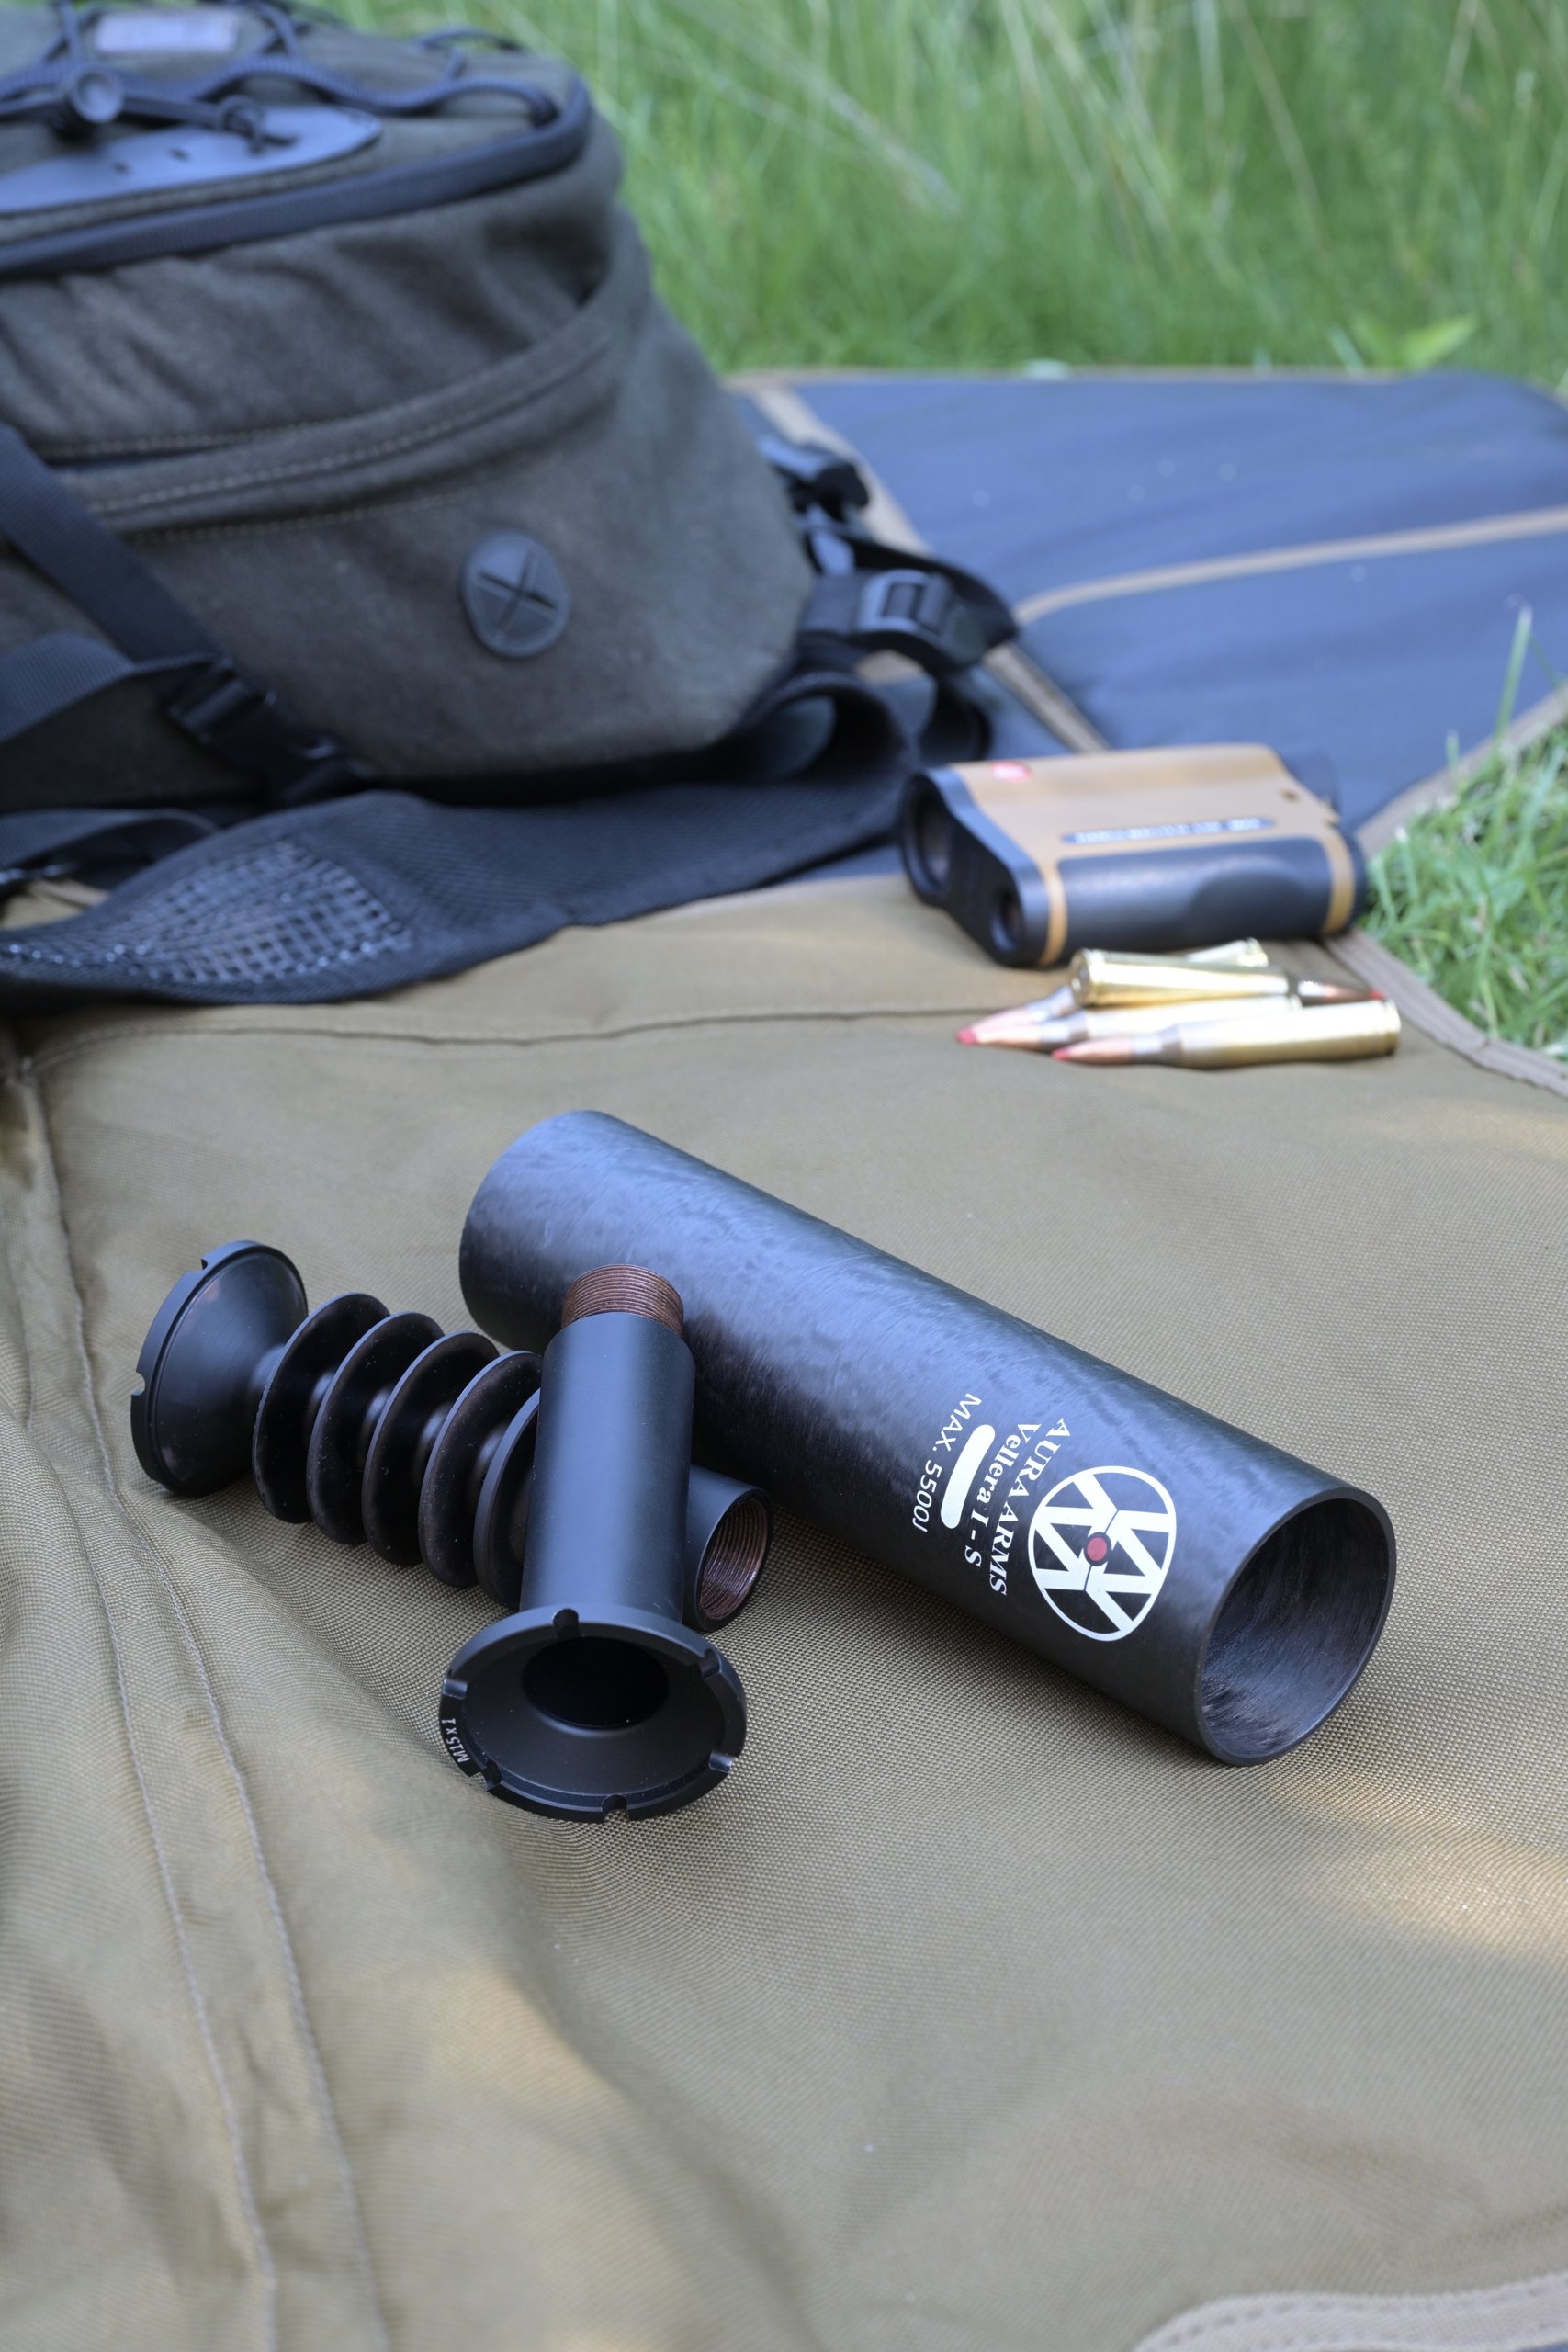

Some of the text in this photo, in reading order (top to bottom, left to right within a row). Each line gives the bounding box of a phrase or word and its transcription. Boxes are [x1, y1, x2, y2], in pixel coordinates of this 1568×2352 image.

[912, 1392, 983, 1532] MAX. 5500J
[976, 1423, 1043, 1504] Vellera
[989, 1418, 1071, 1596] AURA ARMS
[964, 1544, 982, 1567] S
